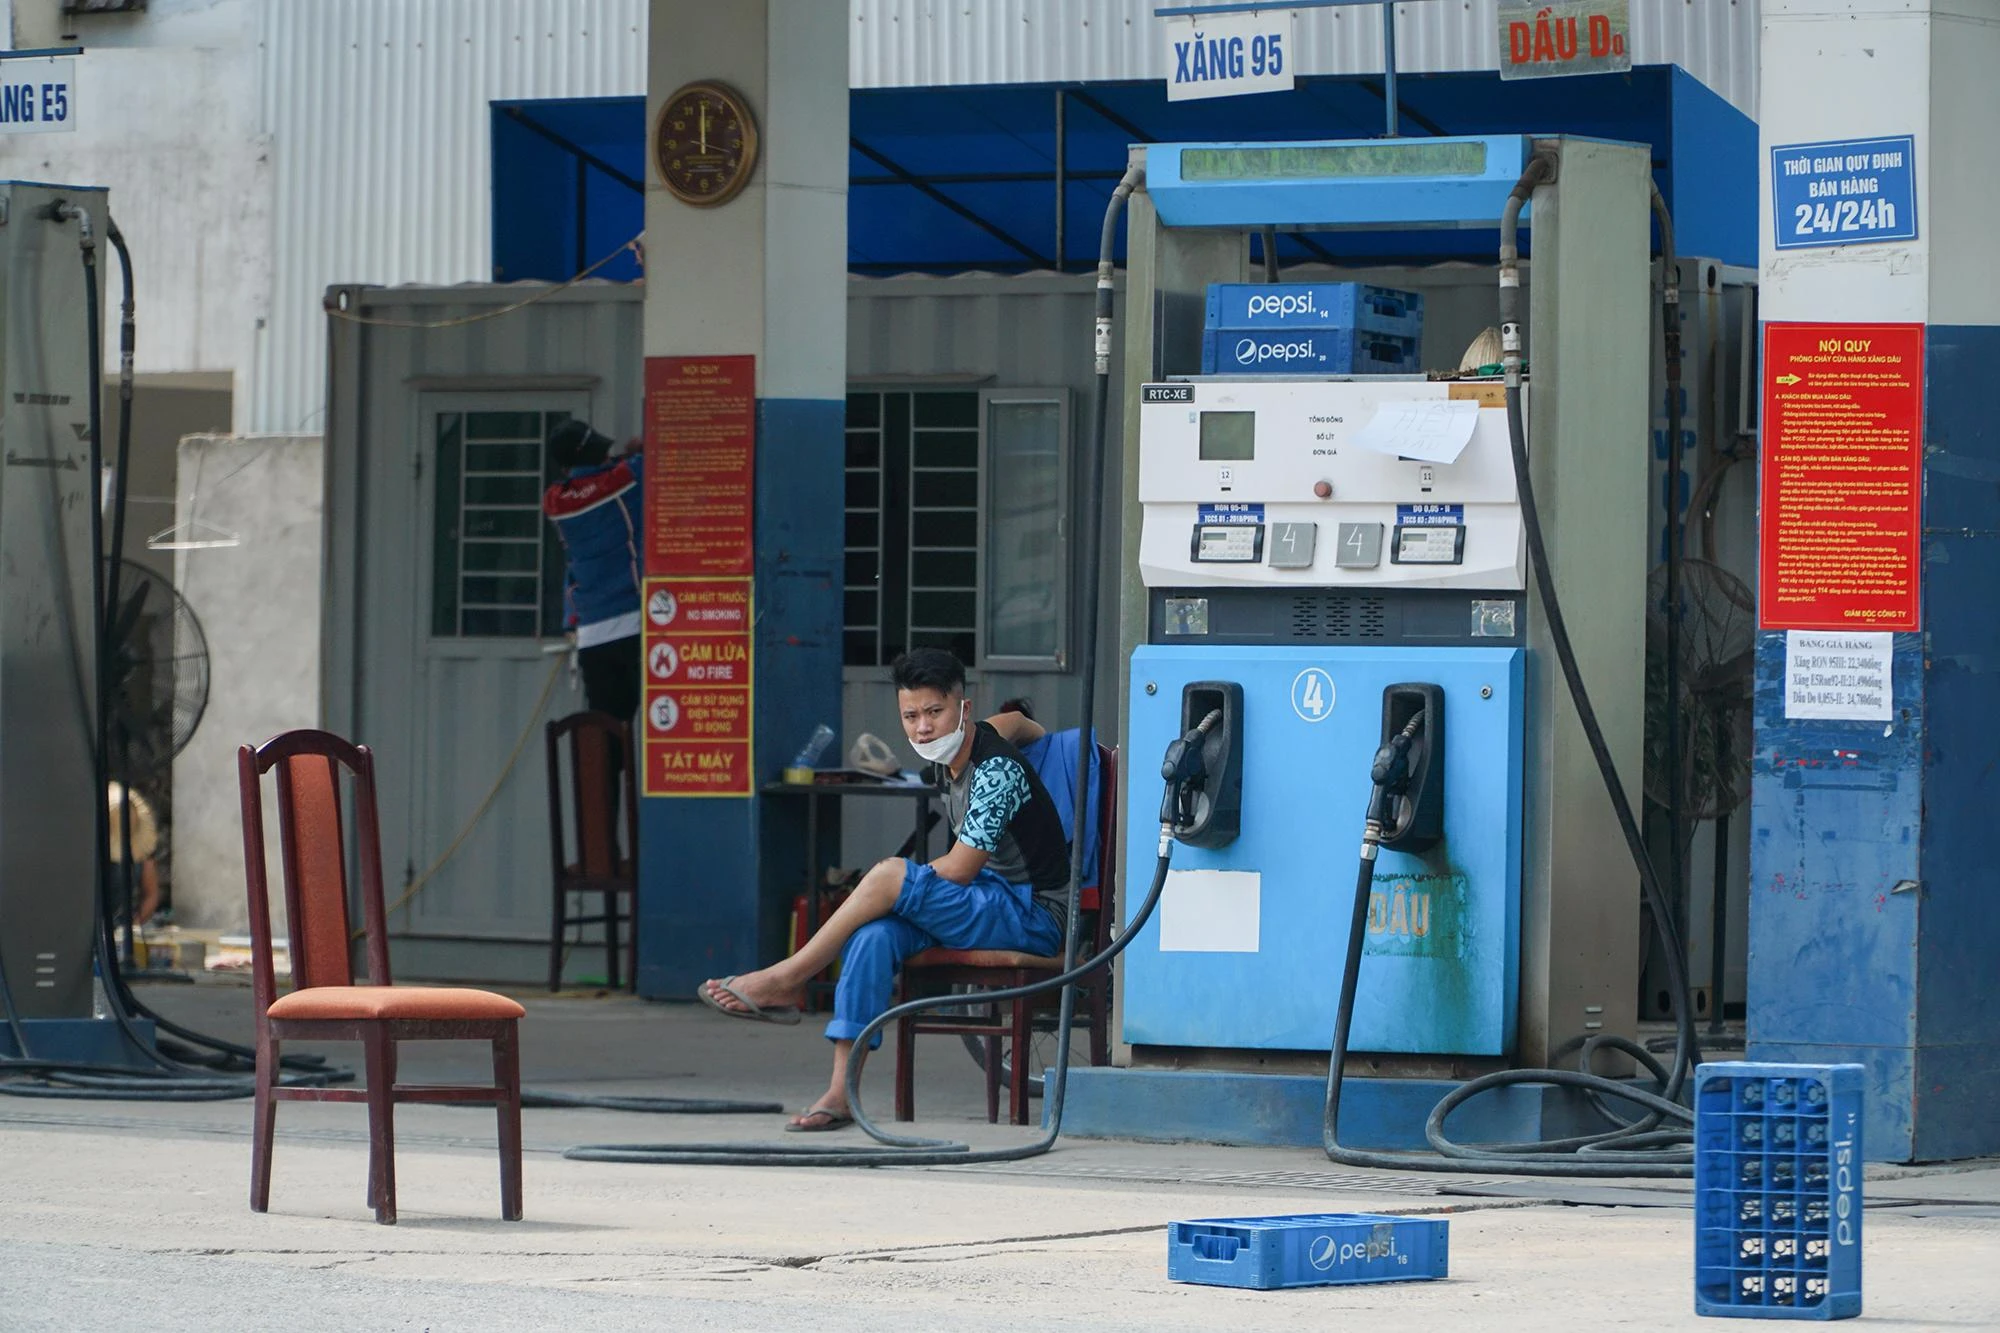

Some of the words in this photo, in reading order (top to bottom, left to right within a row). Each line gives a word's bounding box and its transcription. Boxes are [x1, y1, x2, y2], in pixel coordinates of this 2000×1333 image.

[1509, 7, 1578, 65] DẦU
[1174, 32, 1244, 83] XĂNG
[1251, 34, 1283, 77] 95
[42, 84, 67, 121] E5
[1784, 156, 1811, 176] THỜI
[1814, 156, 1843, 174] GIAN
[1846, 154, 1869, 173] QUY
[1872, 152, 1902, 172] ĐỊNH
[1809, 179, 1837, 197] BÁN
[1841, 176, 1878, 195] HÀNG
[1795, 198, 1896, 235] 24/24h
[1819, 338, 1841, 354] NỘI
[1844, 340, 1871, 352] QUY
[1814, 355, 1831, 363] CHÁY
[1848, 355, 1866, 363] HÀNG
[1149, 389, 1187, 399] RTC-XE
[1222, 471, 1230, 479] 12
[1282, 524, 1296, 553] 4
[1346, 525, 1362, 557] 4
[687, 609, 700, 620] NO
[702, 609, 741, 620] SMOKING
[1898, 610, 1906, 618] TY
[680, 641, 712, 661] CẤM
[715, 640, 746, 661] LỬA
[1826, 638, 1843, 649] GIÁ
[1811, 656, 1828, 668] RON
[687, 666, 705, 679] NO
[706, 665, 733, 680] FIRE
[1303, 674, 1324, 716] 4
[662, 750, 695, 768] TẤT
[698, 749, 734, 768] MÁY
[1369, 880, 1430, 937] DẦU
[1397, 1255, 1408, 1265] 16
